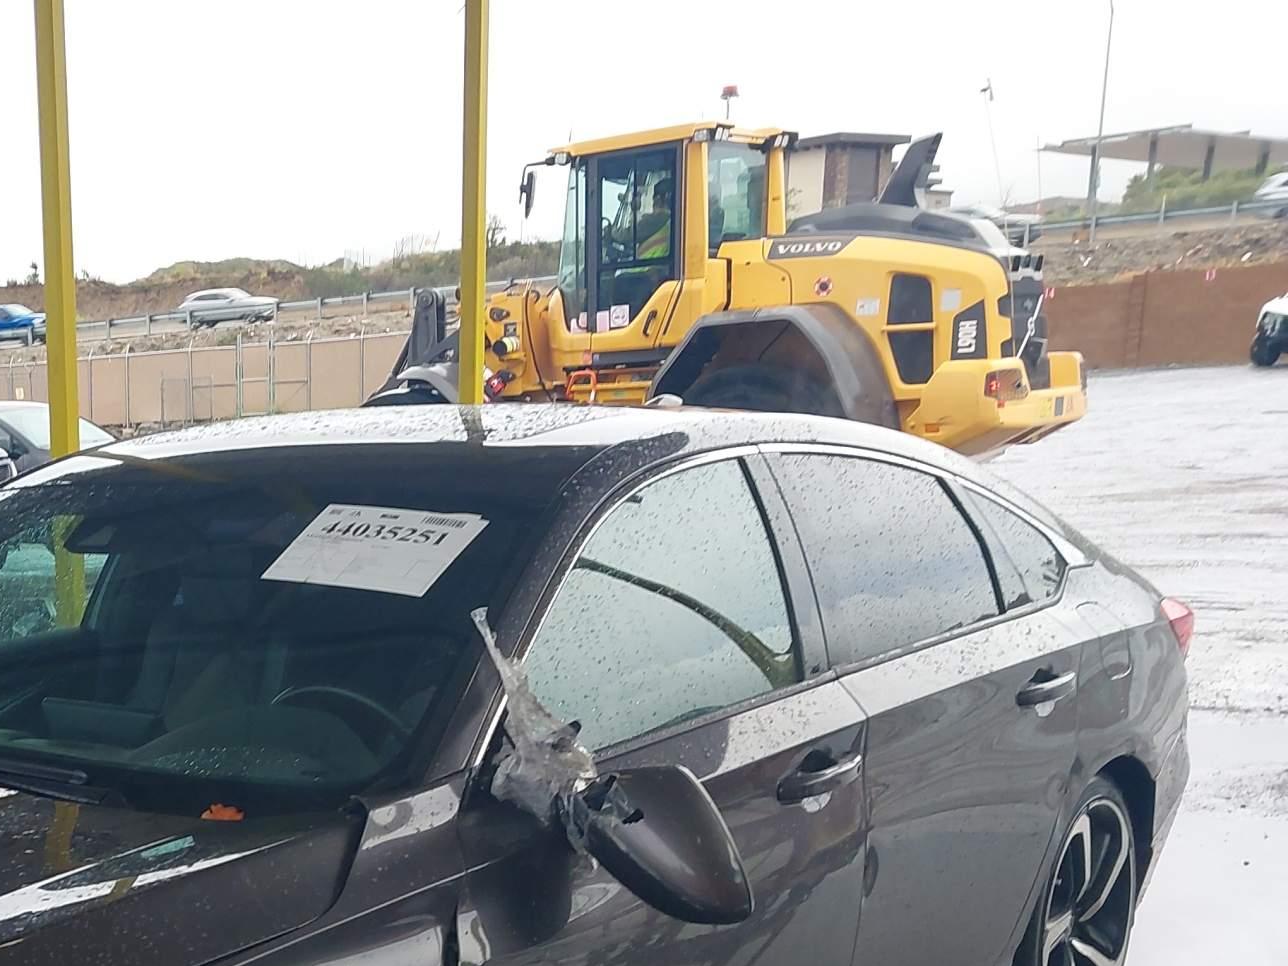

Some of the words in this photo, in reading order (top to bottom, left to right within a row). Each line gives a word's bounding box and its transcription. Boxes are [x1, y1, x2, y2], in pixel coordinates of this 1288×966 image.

[777, 241, 842, 255] VOLVO
[957, 319, 978, 353] L90H
[321, 520, 449, 546] 44035251
